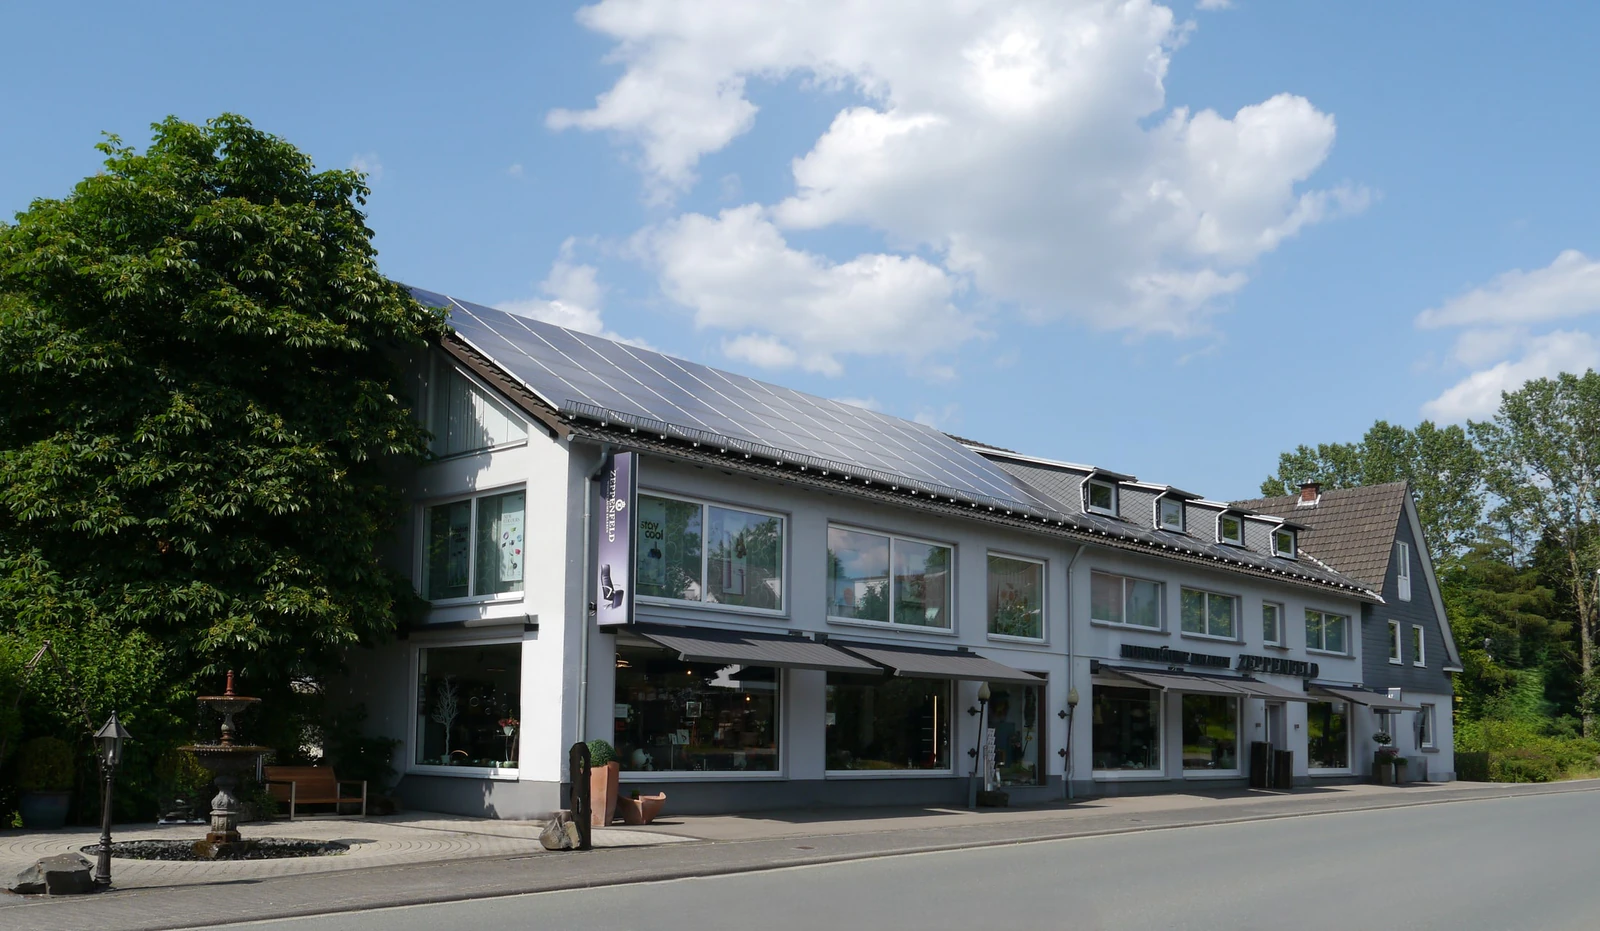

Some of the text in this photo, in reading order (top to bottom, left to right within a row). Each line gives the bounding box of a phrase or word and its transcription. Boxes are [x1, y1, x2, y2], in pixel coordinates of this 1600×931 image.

[609, 469, 617, 543] ZEPPENFELD
[640, 520, 659, 532] stay
[645, 529, 664, 540] cool
[1235, 654, 1320, 678] ZEPPENFELD
